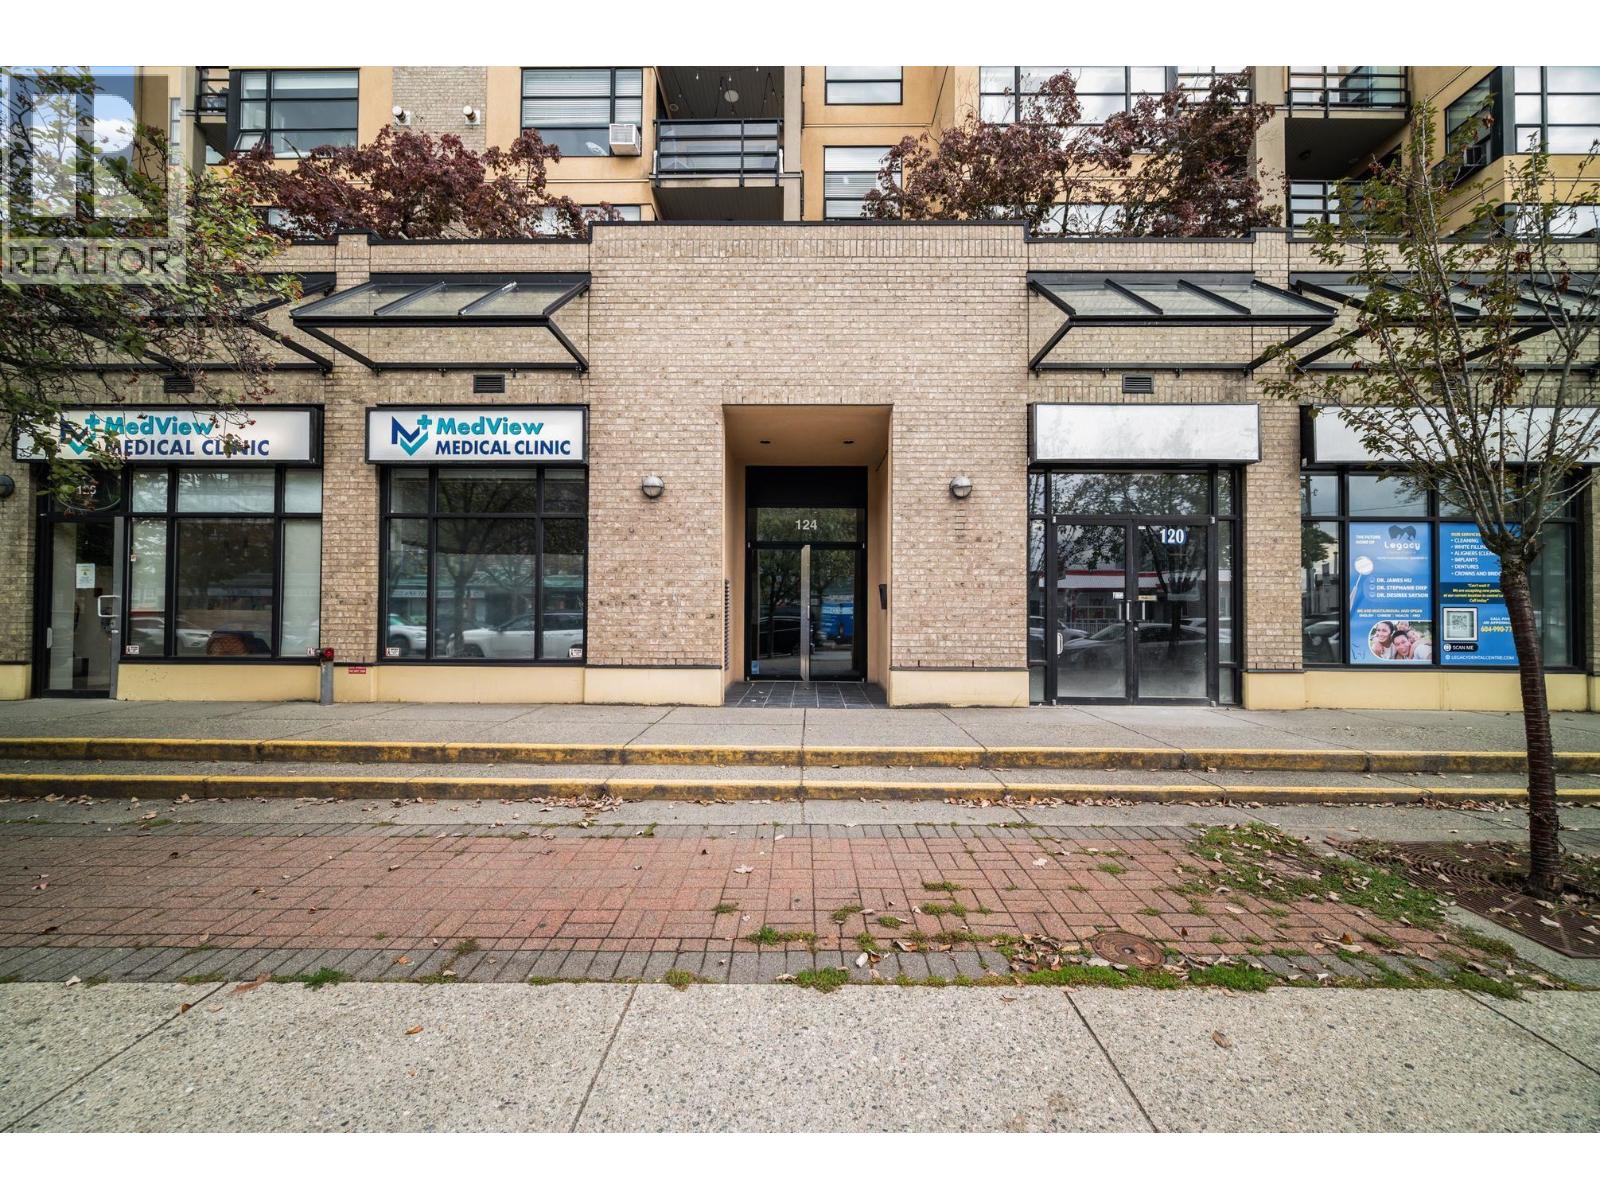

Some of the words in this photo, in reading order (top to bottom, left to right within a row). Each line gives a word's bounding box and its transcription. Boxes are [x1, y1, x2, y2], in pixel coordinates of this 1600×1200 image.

[105, 414, 214, 436] MedView
[436, 416, 544, 435] MedView
[435, 440, 511, 455] MEDICAL
[514, 440, 571, 455] CLINIC
[795, 519, 817, 530] 124
[1160, 528, 1186, 544] 120
[1384, 541, 1421, 551] Legacy
